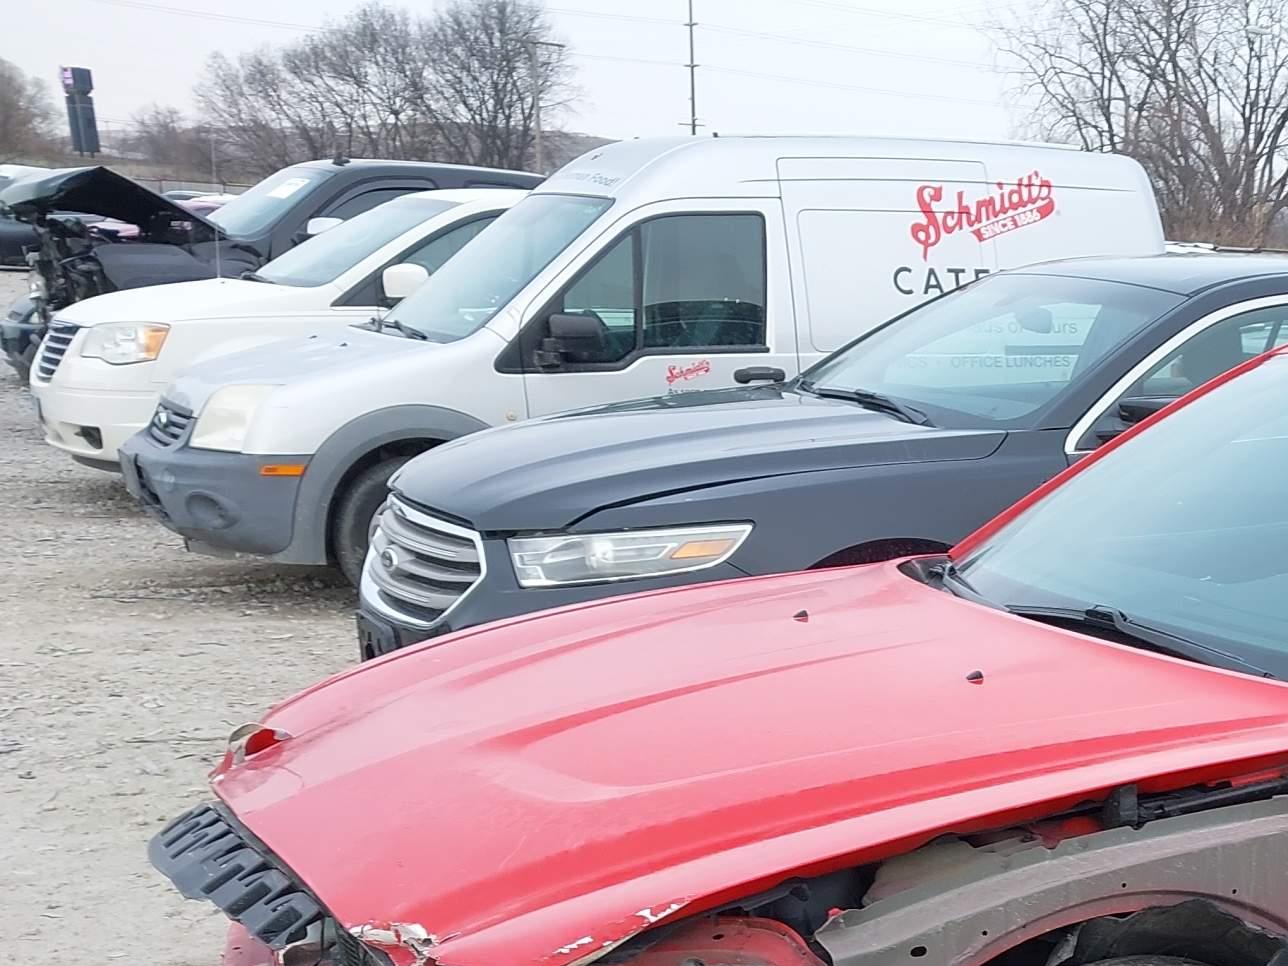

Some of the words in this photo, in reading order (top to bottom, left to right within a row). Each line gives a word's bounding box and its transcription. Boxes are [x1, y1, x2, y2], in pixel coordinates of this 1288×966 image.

[910, 170, 1052, 262] Schmidt's
[980, 217, 1016, 239] SINCE
[950, 355, 1003, 368] OFFICE
[1005, 355, 1071, 368] LUNCHES
